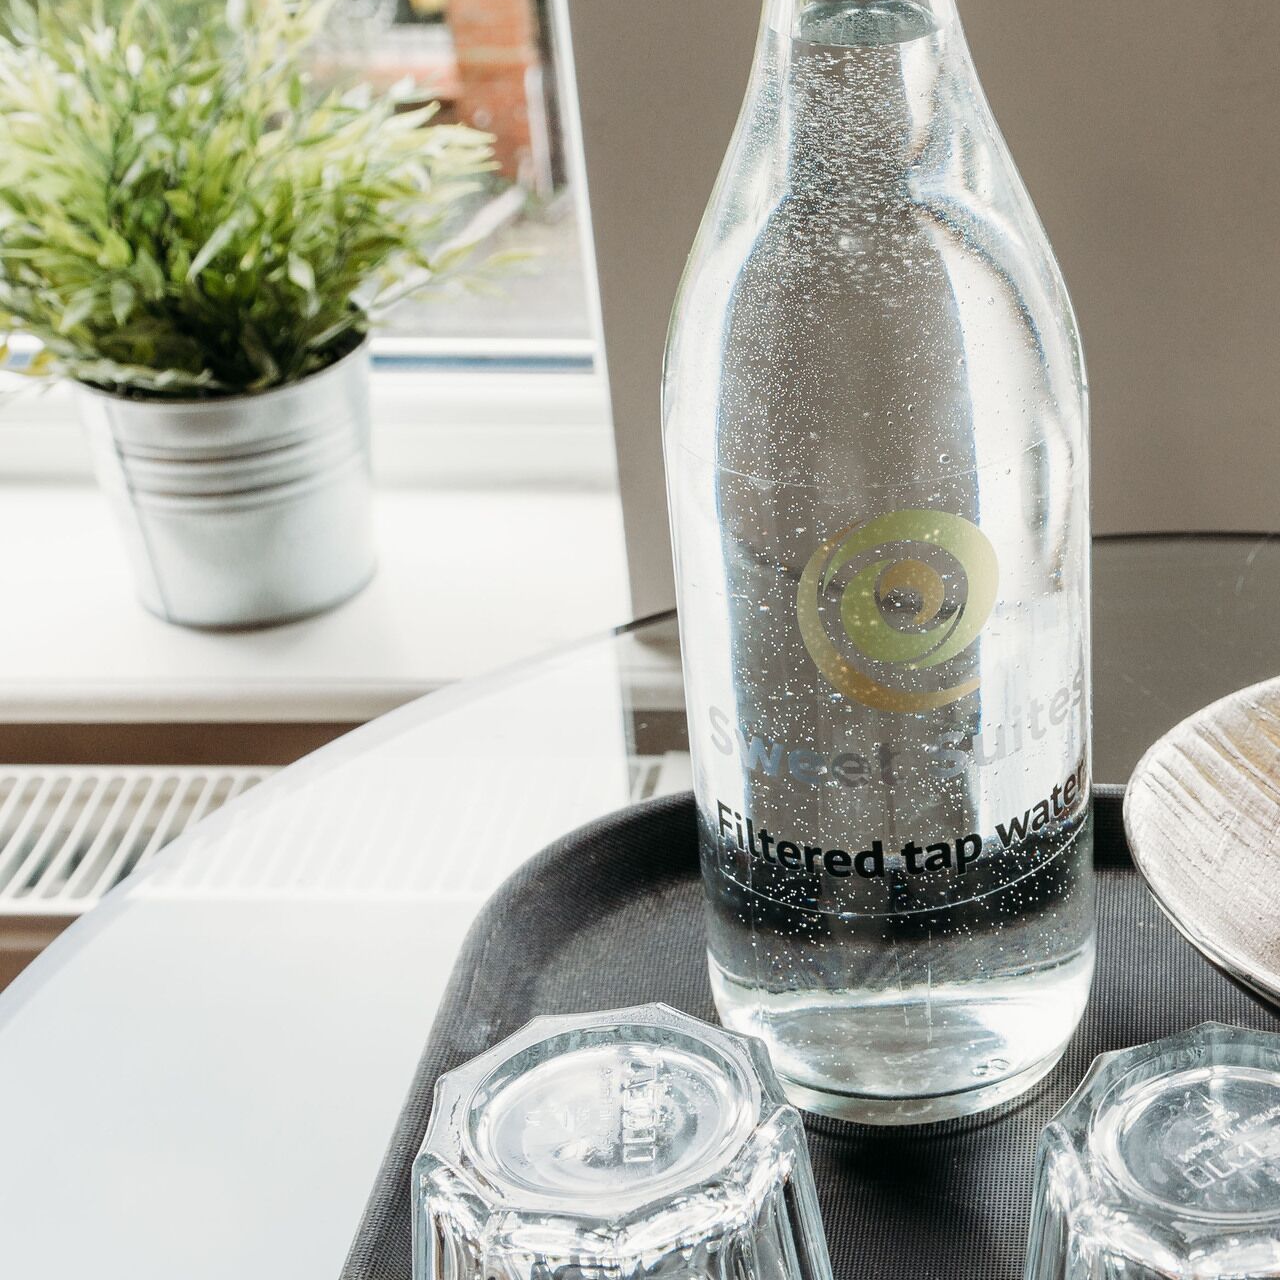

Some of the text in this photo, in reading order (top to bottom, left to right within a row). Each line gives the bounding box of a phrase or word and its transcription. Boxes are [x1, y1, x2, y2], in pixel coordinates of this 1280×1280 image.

[708, 666, 1084, 788] Sweet Suites
[716, 758, 1086, 879] Filtered tap water
